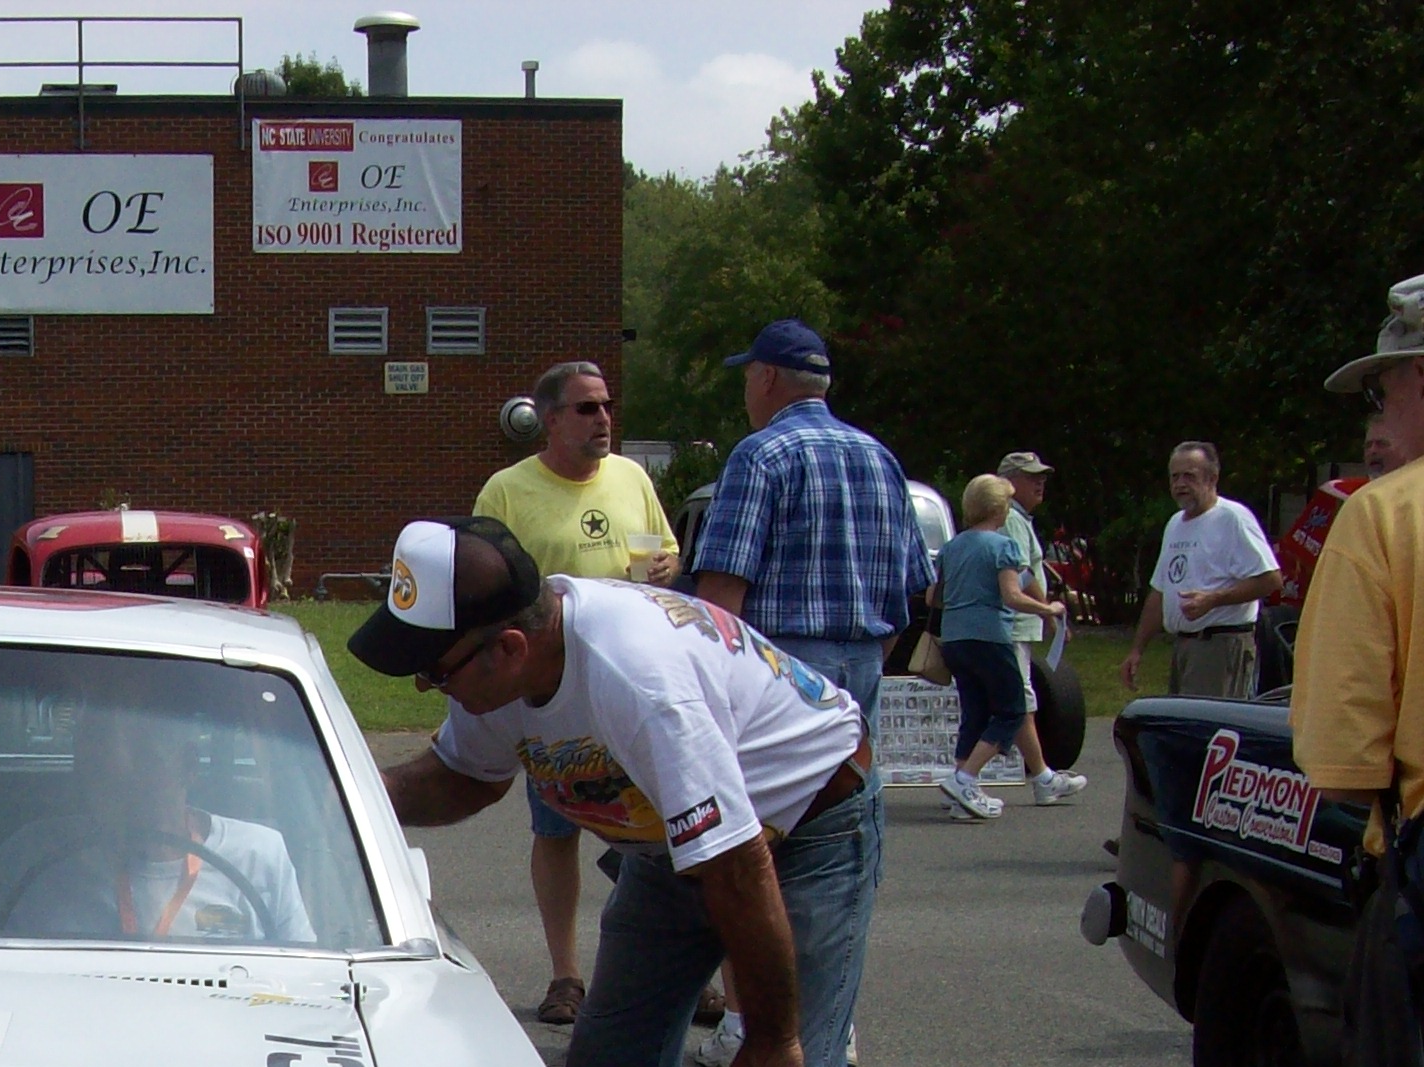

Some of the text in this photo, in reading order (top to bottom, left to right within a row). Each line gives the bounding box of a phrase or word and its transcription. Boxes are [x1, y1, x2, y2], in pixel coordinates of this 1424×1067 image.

[261, 127, 455, 146] NC STATE UNIVERSITY Congratulates
[360, 164, 406, 189] OE
[82, 190, 165, 234] OE
[256, 222, 457, 251] ISO 9001 Registered
